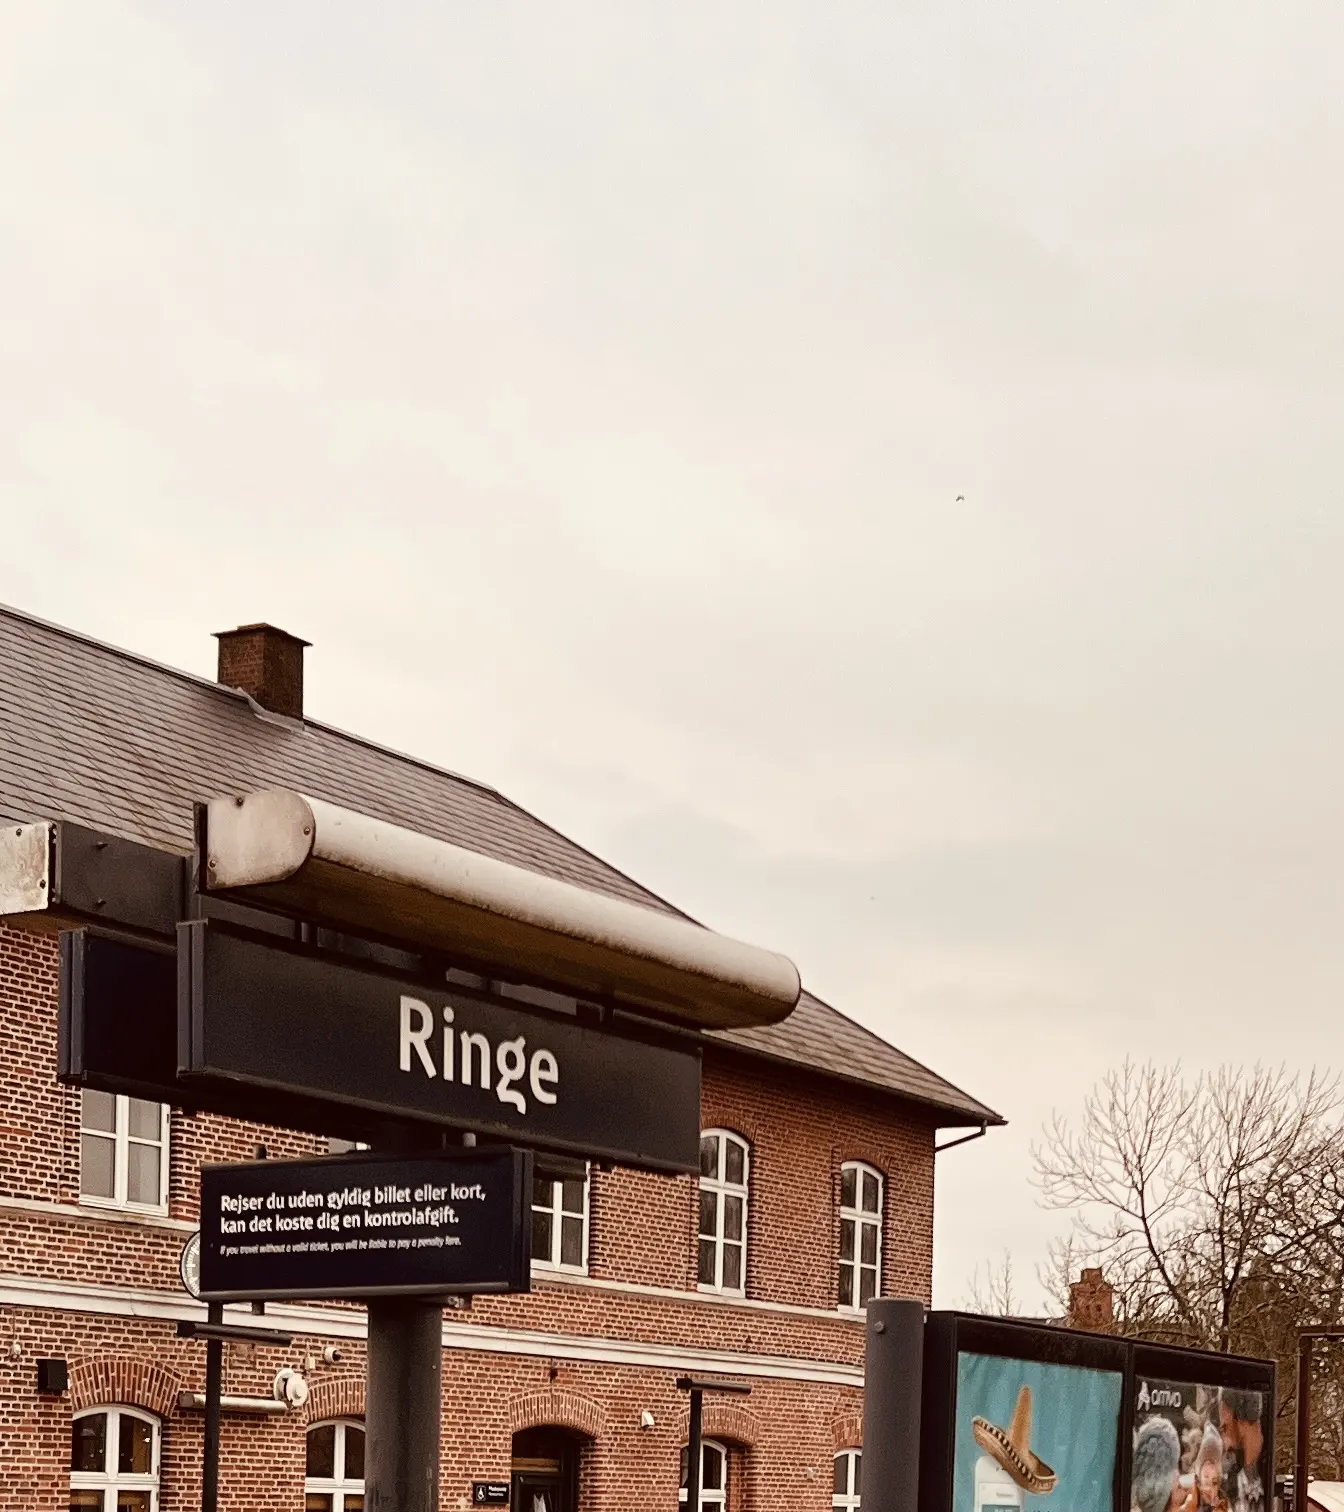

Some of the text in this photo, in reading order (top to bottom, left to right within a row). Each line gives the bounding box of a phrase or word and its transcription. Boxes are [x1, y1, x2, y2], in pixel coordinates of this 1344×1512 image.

[399, 995, 559, 1115] Ringe
[221, 1182, 486, 1214] Rejser du uden gyldig billet eller kort,
[220, 1205, 460, 1233] kan det koste dig en kontrolafgift.
